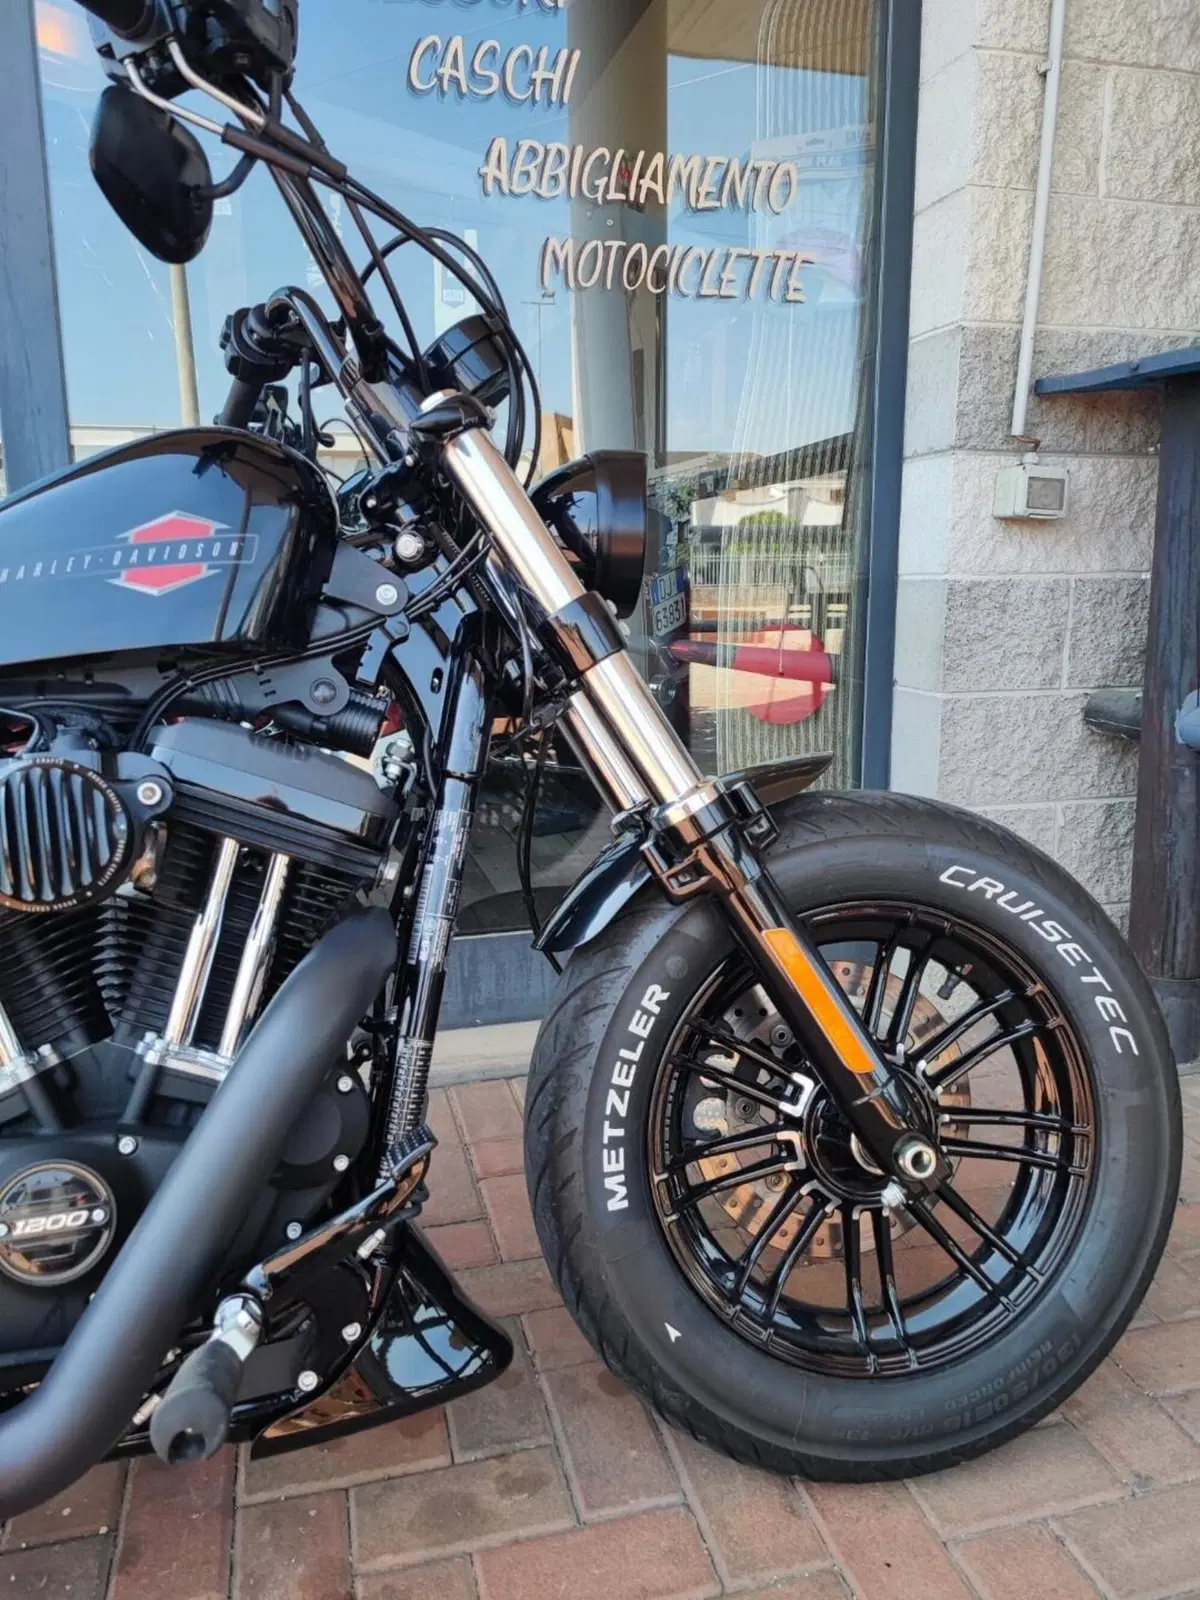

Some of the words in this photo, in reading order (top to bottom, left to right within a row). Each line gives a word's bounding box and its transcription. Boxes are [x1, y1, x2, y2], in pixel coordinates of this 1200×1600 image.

[408, 34, 581, 104] CASCHI
[480, 137, 798, 214] ABBIGLIAMENTO
[541, 237, 816, 303] MOTOCICLETTE
[939, 865, 1139, 1056] CRUISETEC
[602, 983, 670, 1212] METZELER
[12, 1210, 90, 1236] 1200
